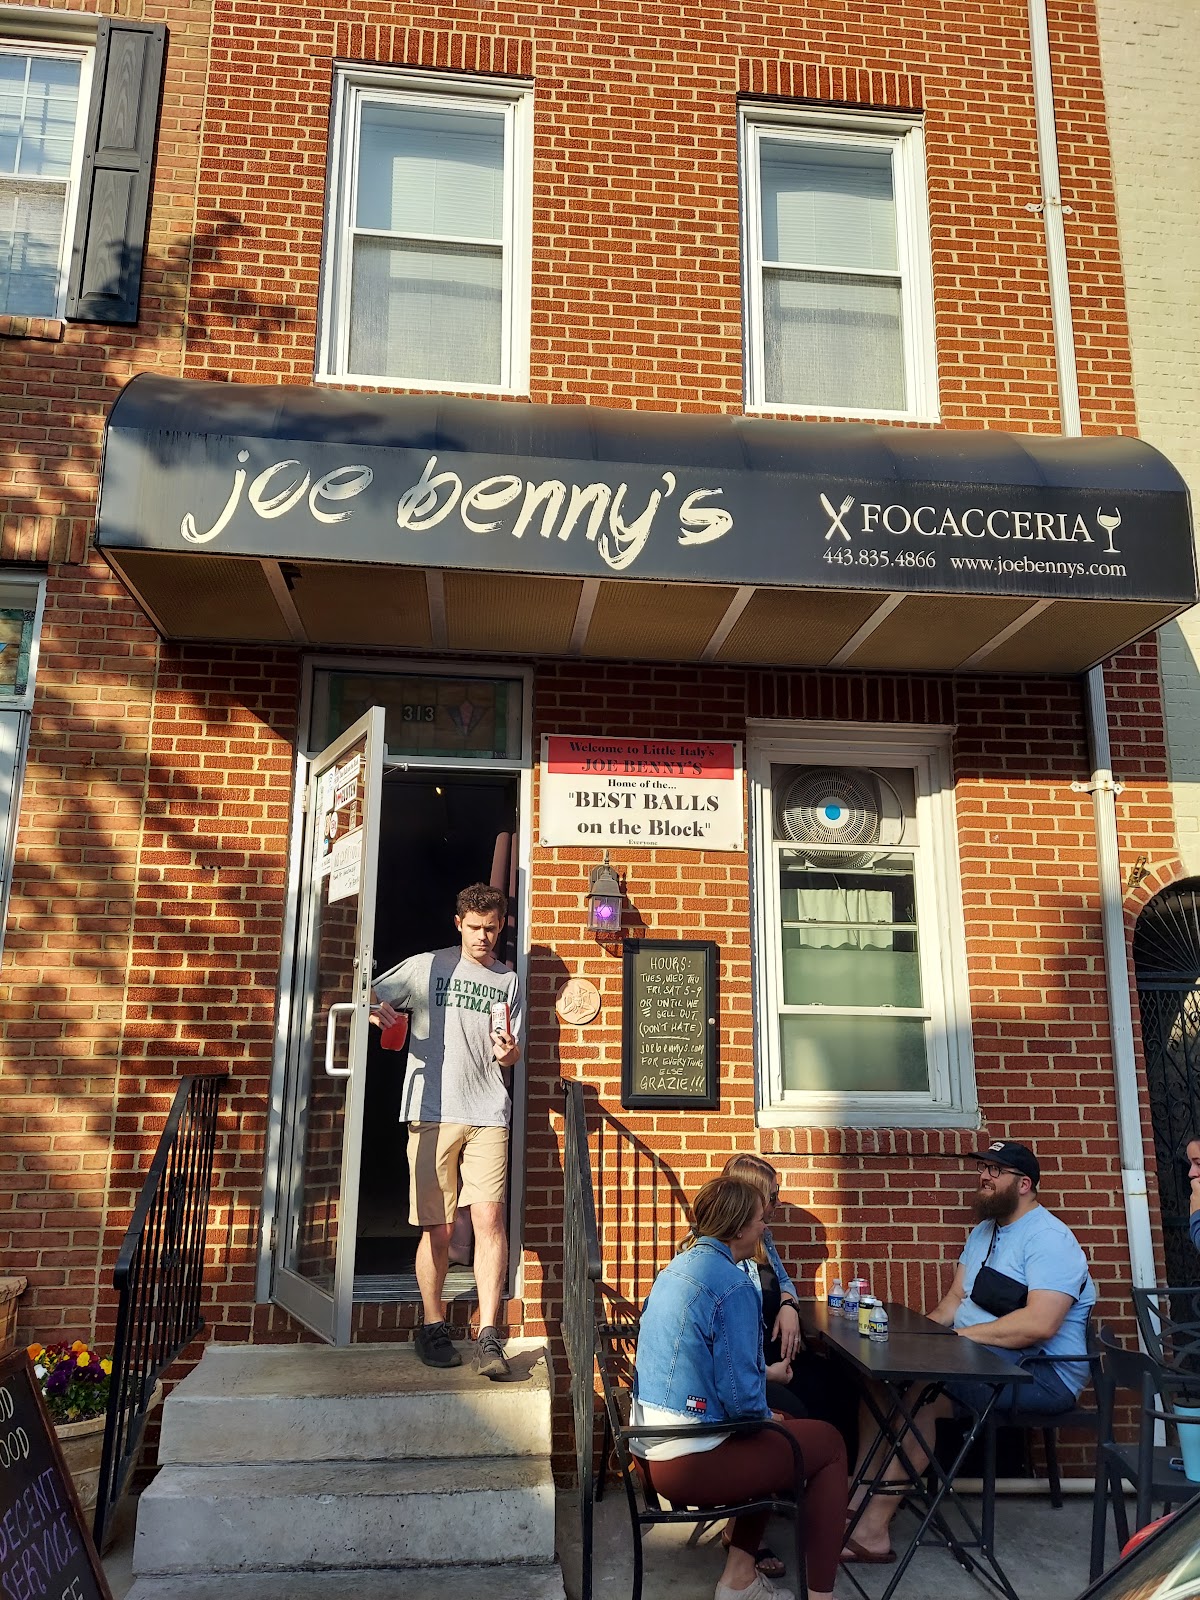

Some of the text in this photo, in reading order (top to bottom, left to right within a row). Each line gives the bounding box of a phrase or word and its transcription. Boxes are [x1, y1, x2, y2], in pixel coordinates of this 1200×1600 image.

[181, 449, 733, 570] joe benny's
[861, 503, 1095, 543] FOCACCERIA
[823, 546, 1127, 578] 443.835.4866 www.joebennys.com
[403, 705, 435, 722] 313
[569, 741, 715, 758] Welcome to Little Italy's
[582, 758, 703, 775] JOE BENNY'S
[608, 779, 677, 789] Home of the...
[568, 791, 719, 812] "BEST BALLS
[577, 818, 711, 837] on the Block"
[650, 956, 692, 973] HOURS:
[663, 985, 682, 996] SAT
[683, 985, 702, 998] 5-9
[639, 998, 653, 1008] OR
[686, 999, 700, 1008] WE
[641, 1056, 659, 1067] FOR
[640, 1075, 705, 1093] GRAZIE!!!
